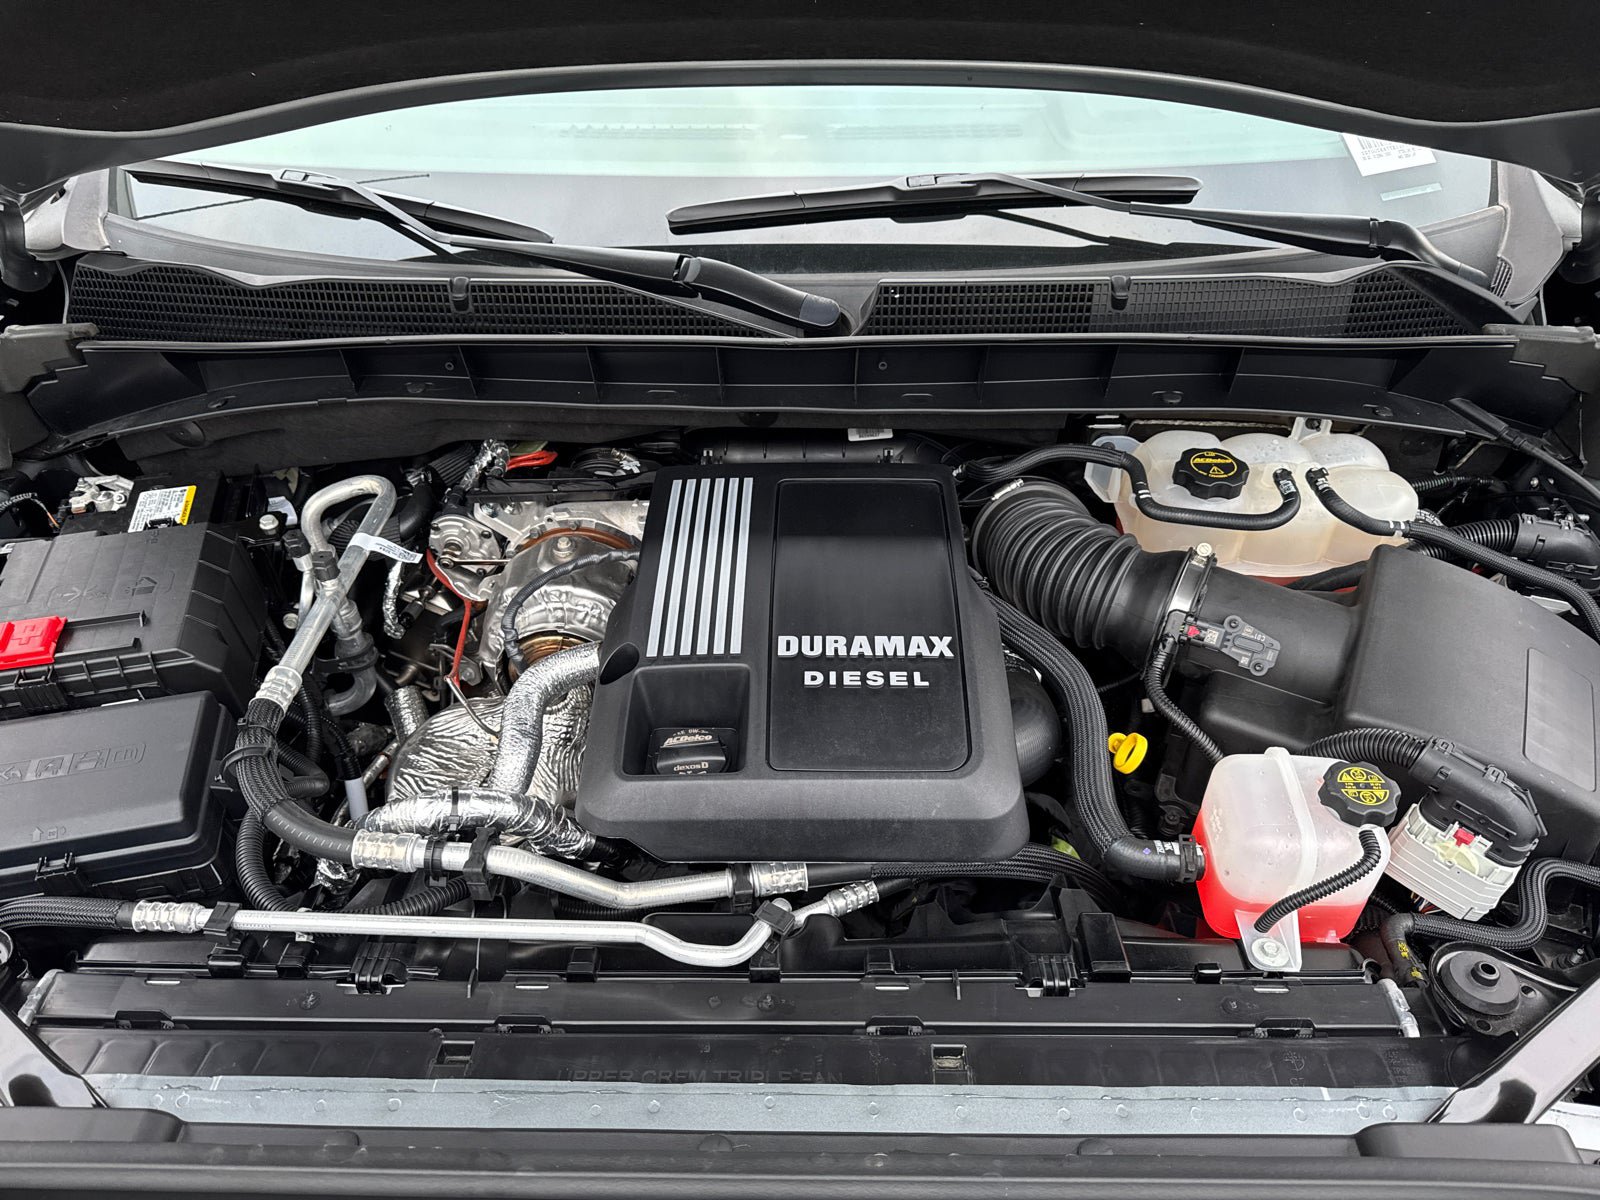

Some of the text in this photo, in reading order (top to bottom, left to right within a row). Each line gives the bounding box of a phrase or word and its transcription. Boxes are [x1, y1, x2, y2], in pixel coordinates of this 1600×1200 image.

[777, 635, 954, 658] DURAMAX
[804, 670, 930, 688] DIESEL
[662, 734, 713, 747] ACDelco
